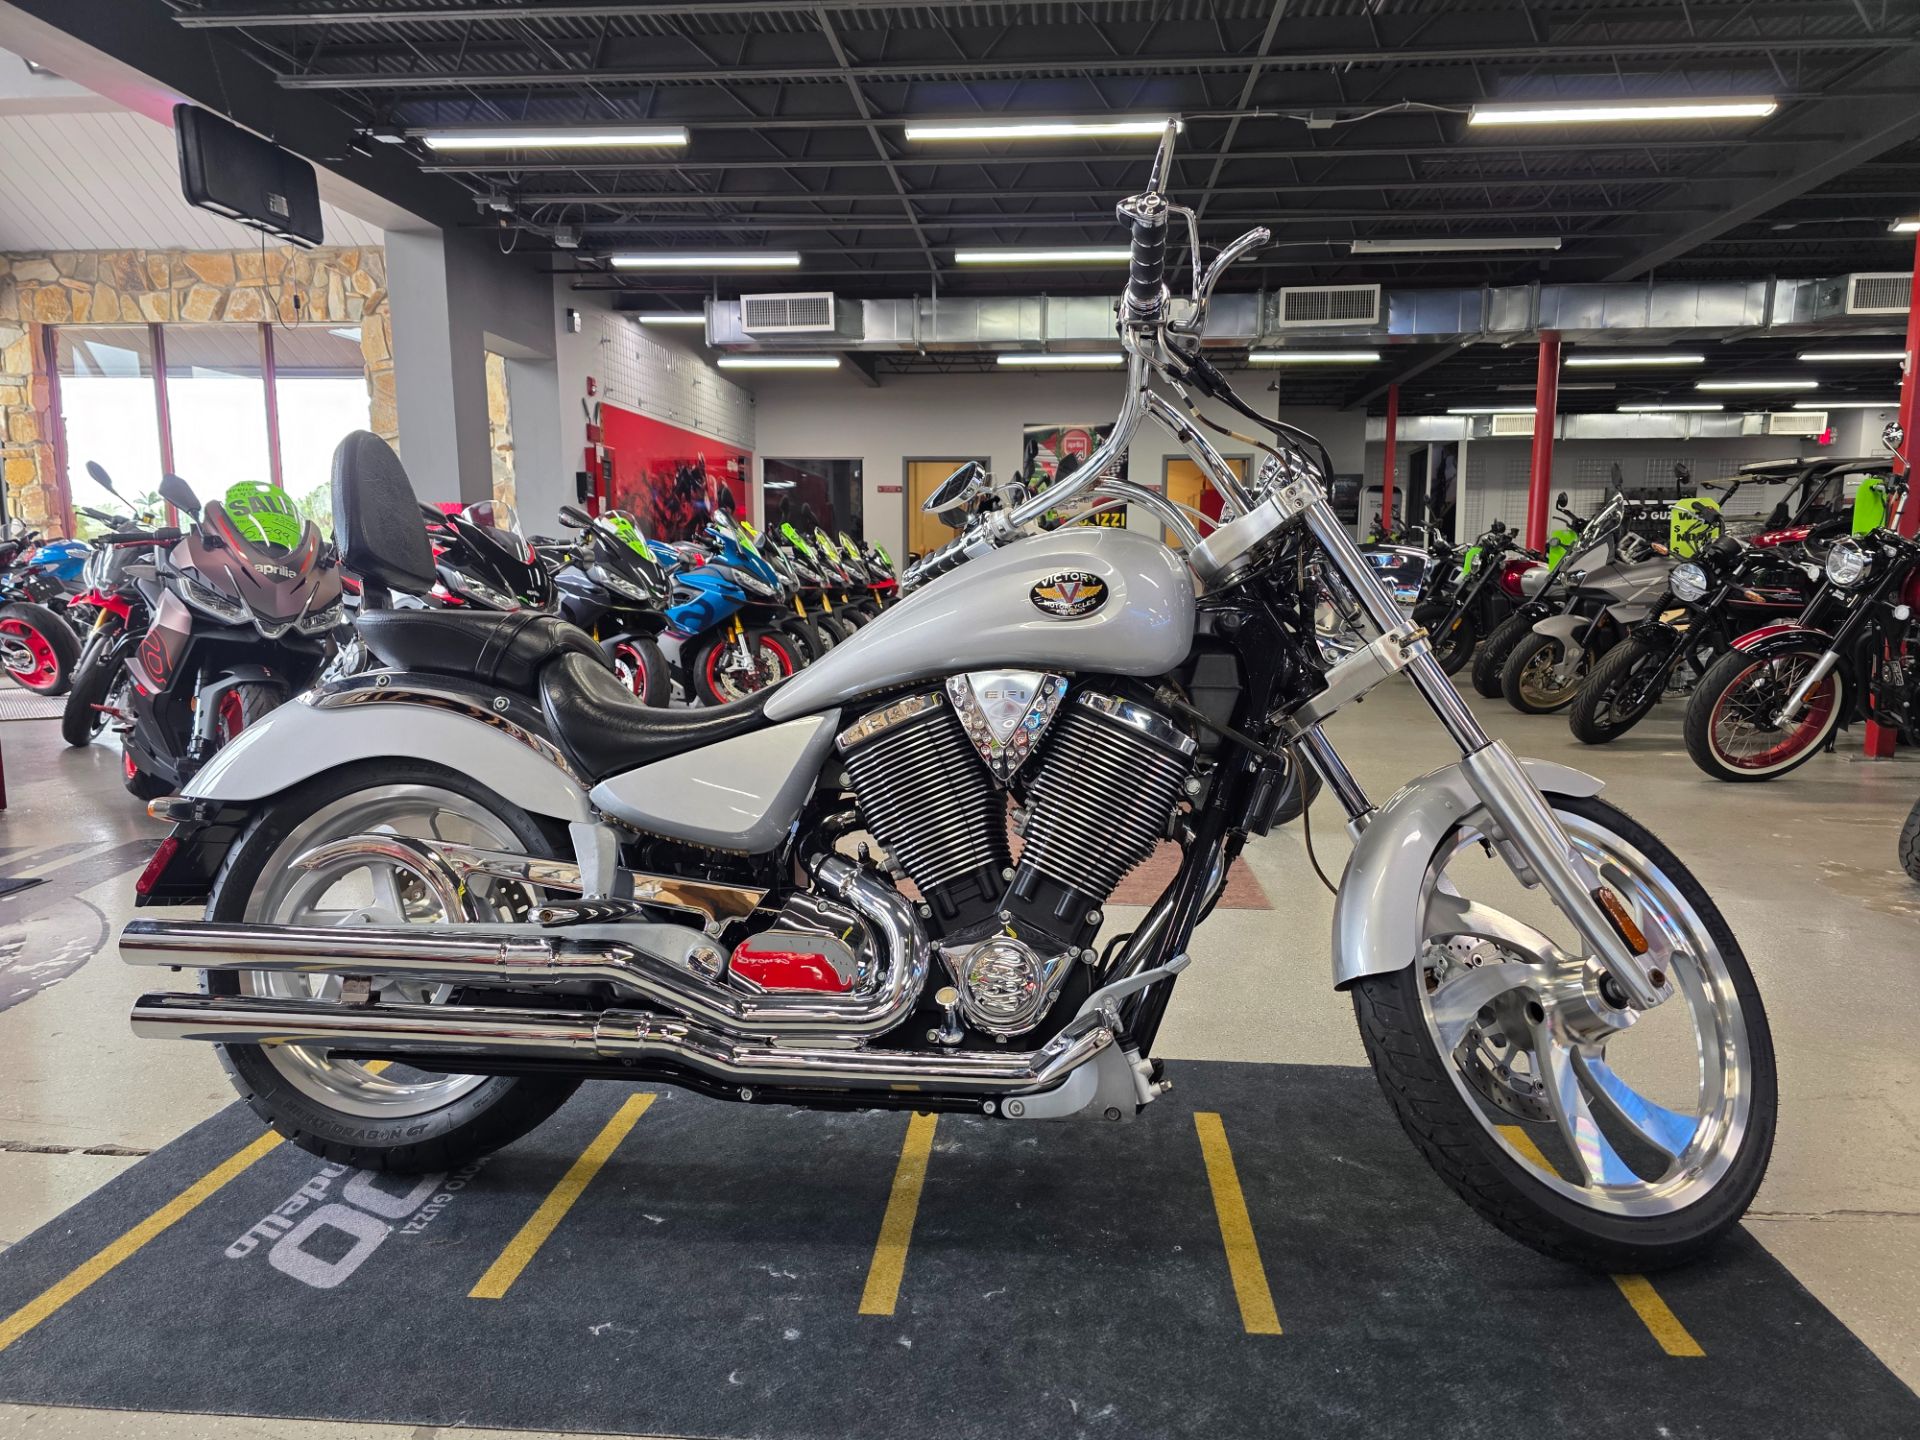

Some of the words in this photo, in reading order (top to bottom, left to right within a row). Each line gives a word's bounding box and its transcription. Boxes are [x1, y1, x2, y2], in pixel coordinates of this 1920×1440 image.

[255, 563, 297, 579] aprilia
[1041, 572, 1097, 586] VICTORY
[224, 1163, 348, 1259] ndello
[399, 1192, 455, 1235] GUZZI
